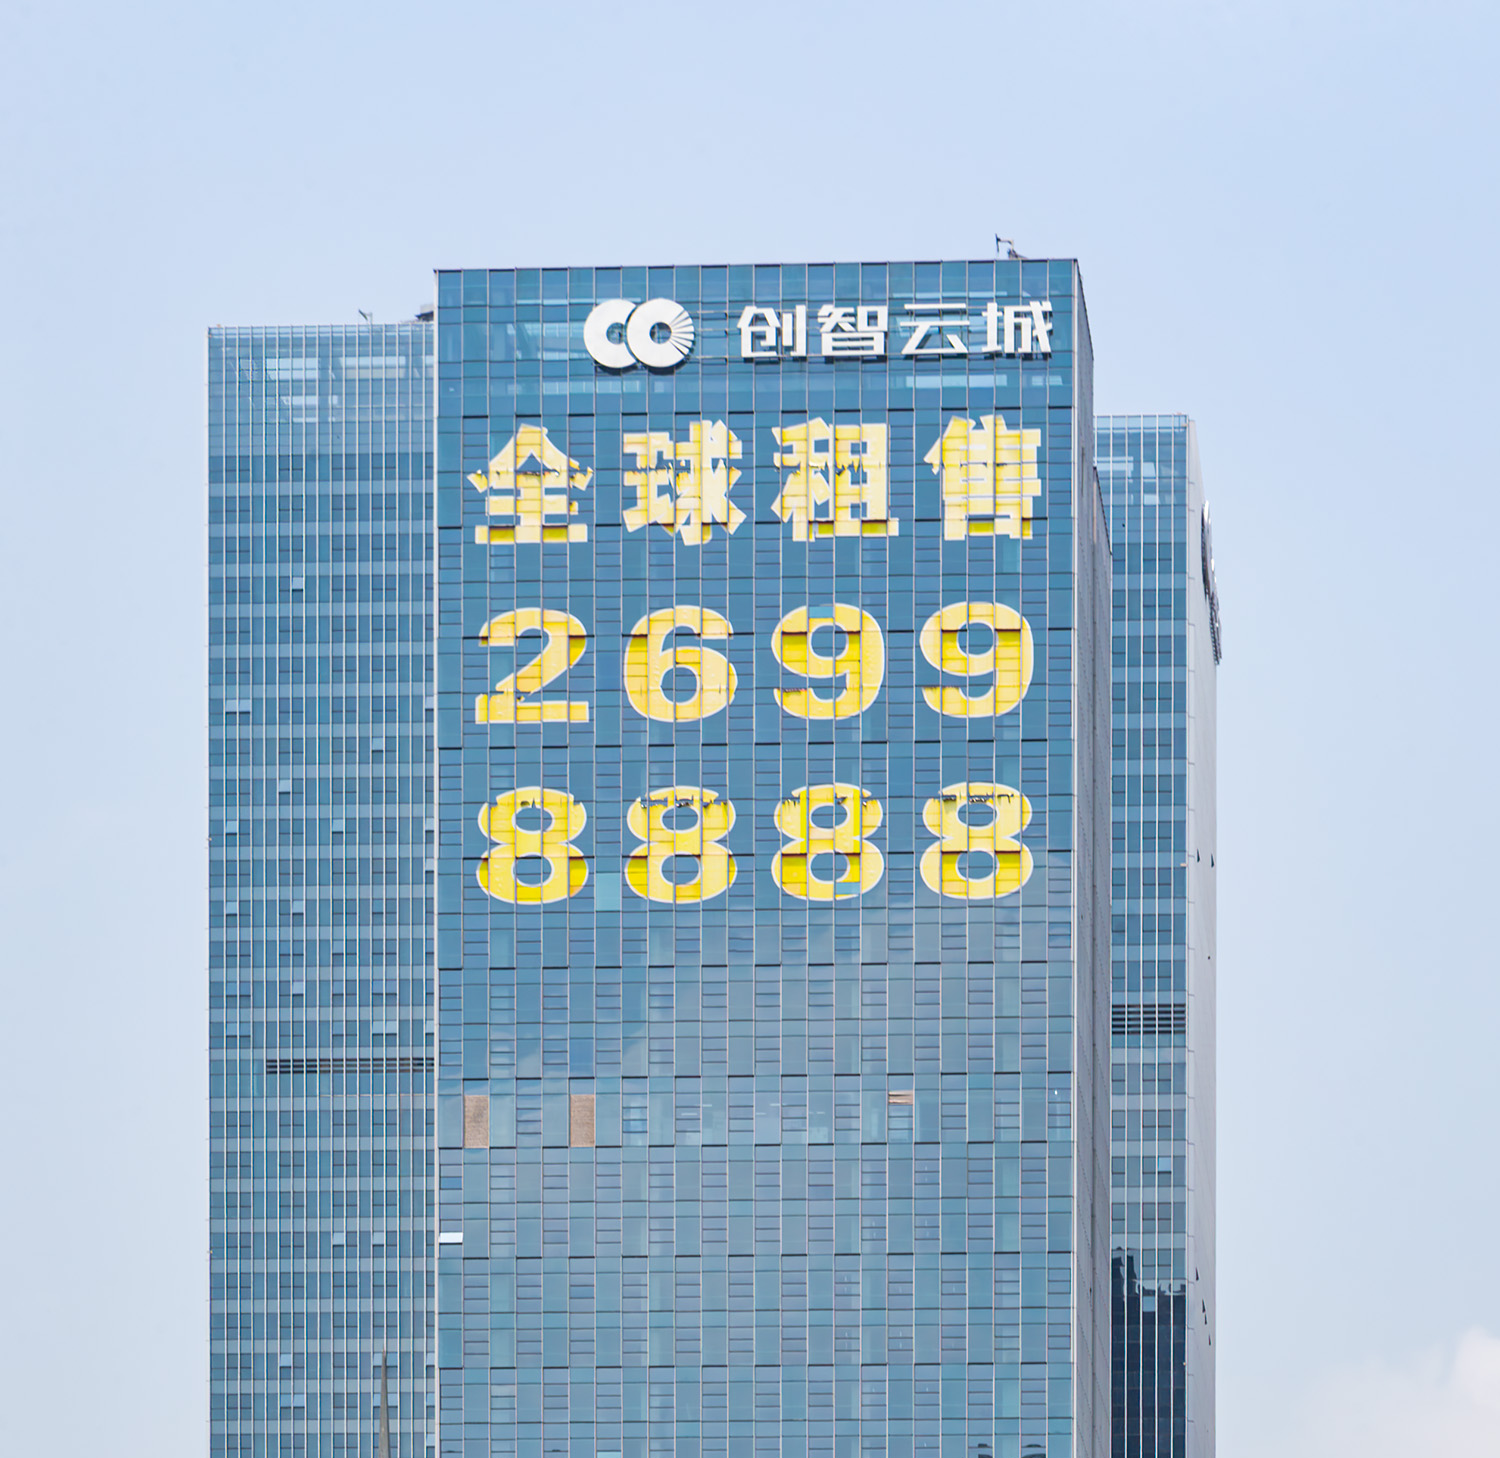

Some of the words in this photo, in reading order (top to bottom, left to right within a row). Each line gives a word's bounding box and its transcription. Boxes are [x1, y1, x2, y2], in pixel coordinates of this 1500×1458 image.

[738, 301, 1053, 358] 创智云城
[467, 414, 1042, 546] 全球租售
[475, 601, 1034, 724] 2699
[476, 782, 1034, 905] 8888
